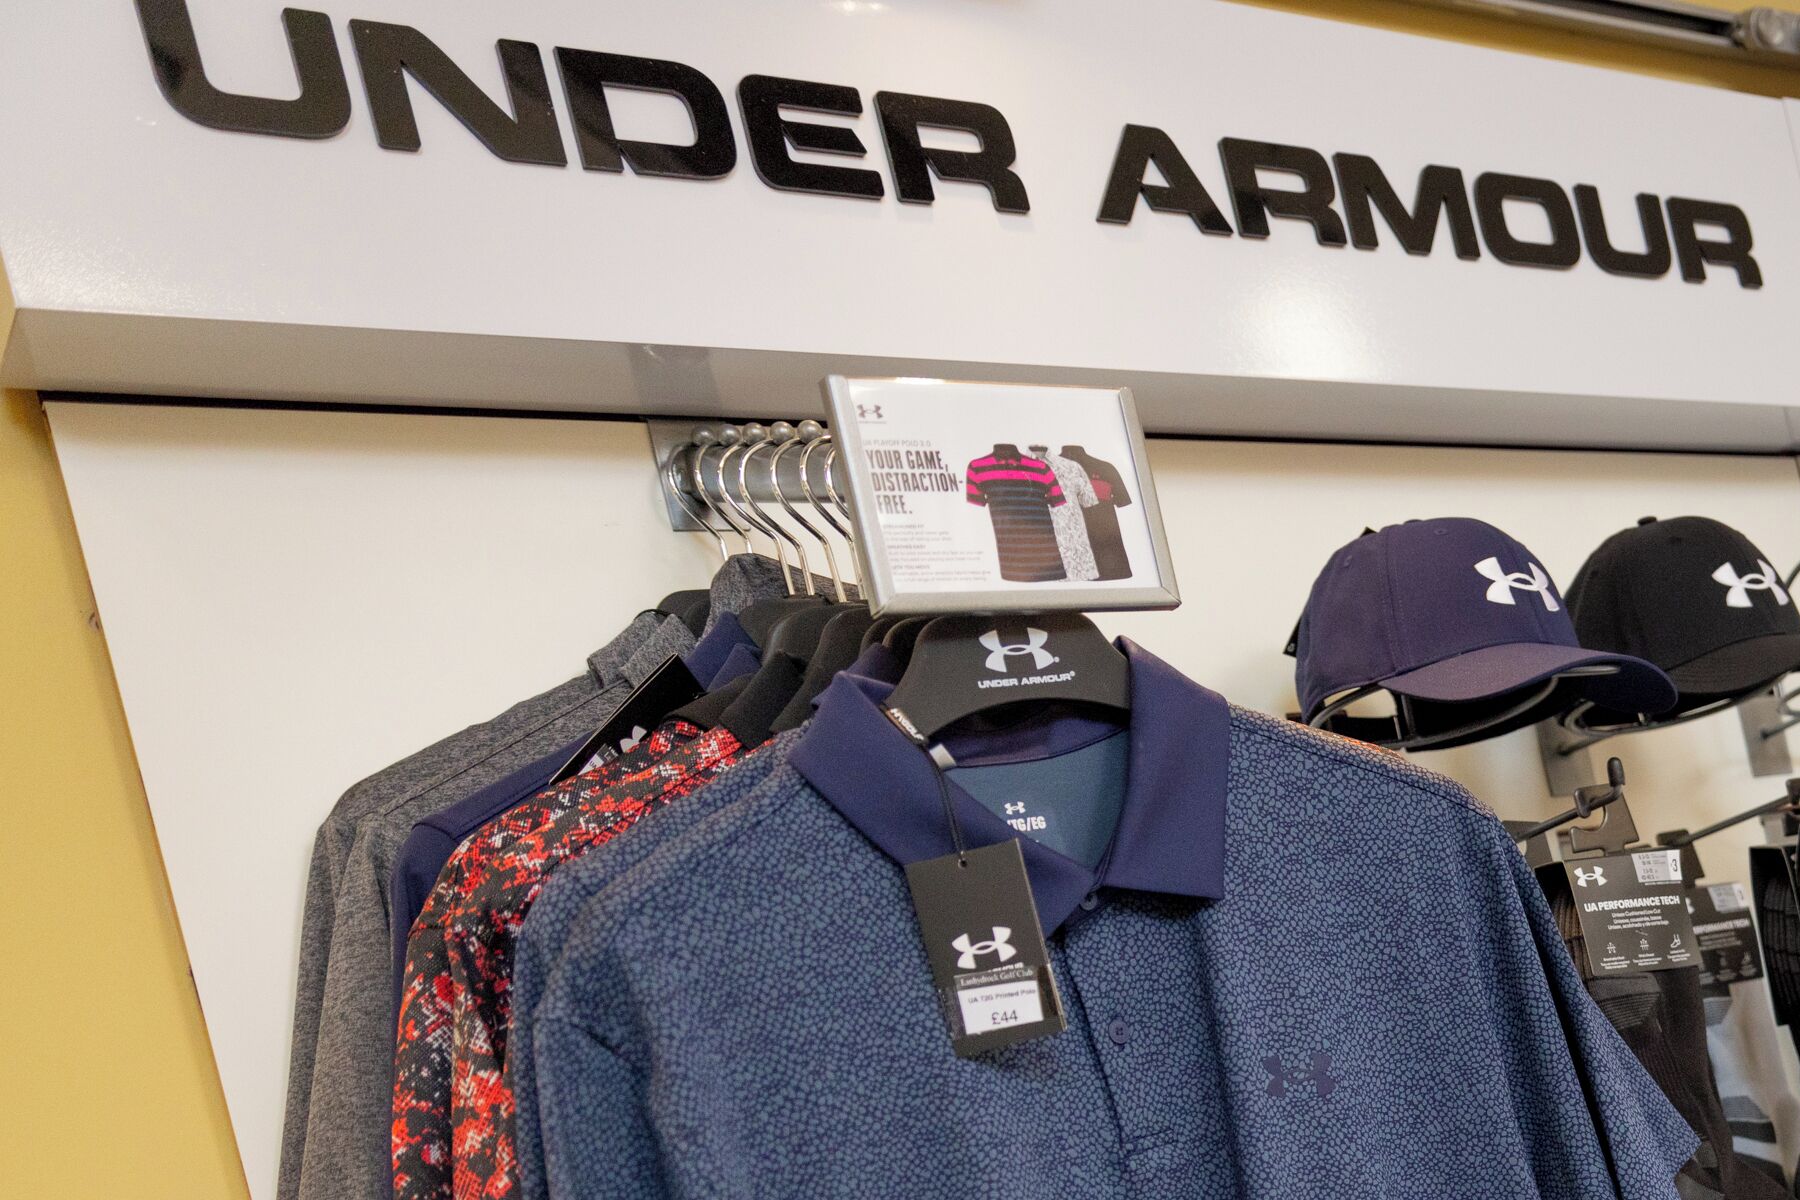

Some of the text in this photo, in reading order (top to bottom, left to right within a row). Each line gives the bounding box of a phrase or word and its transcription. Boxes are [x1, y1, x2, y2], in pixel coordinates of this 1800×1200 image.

[134, 0, 1763, 290] UNDER ARMOUR
[865, 448, 949, 473] YOUR GAME,
[870, 471, 964, 493] DISTRACTION-
[876, 494, 913, 515] FREE.
[978, 677, 1018, 689] UNDER
[1583, 895, 1681, 913] UA PERFORMANCE TECH
[1000, 970, 1016, 980] Golf
[1017, 967, 1034, 978] Club
[995, 990, 1019, 999] Printed
[991, 1009, 1019, 1025] £44
